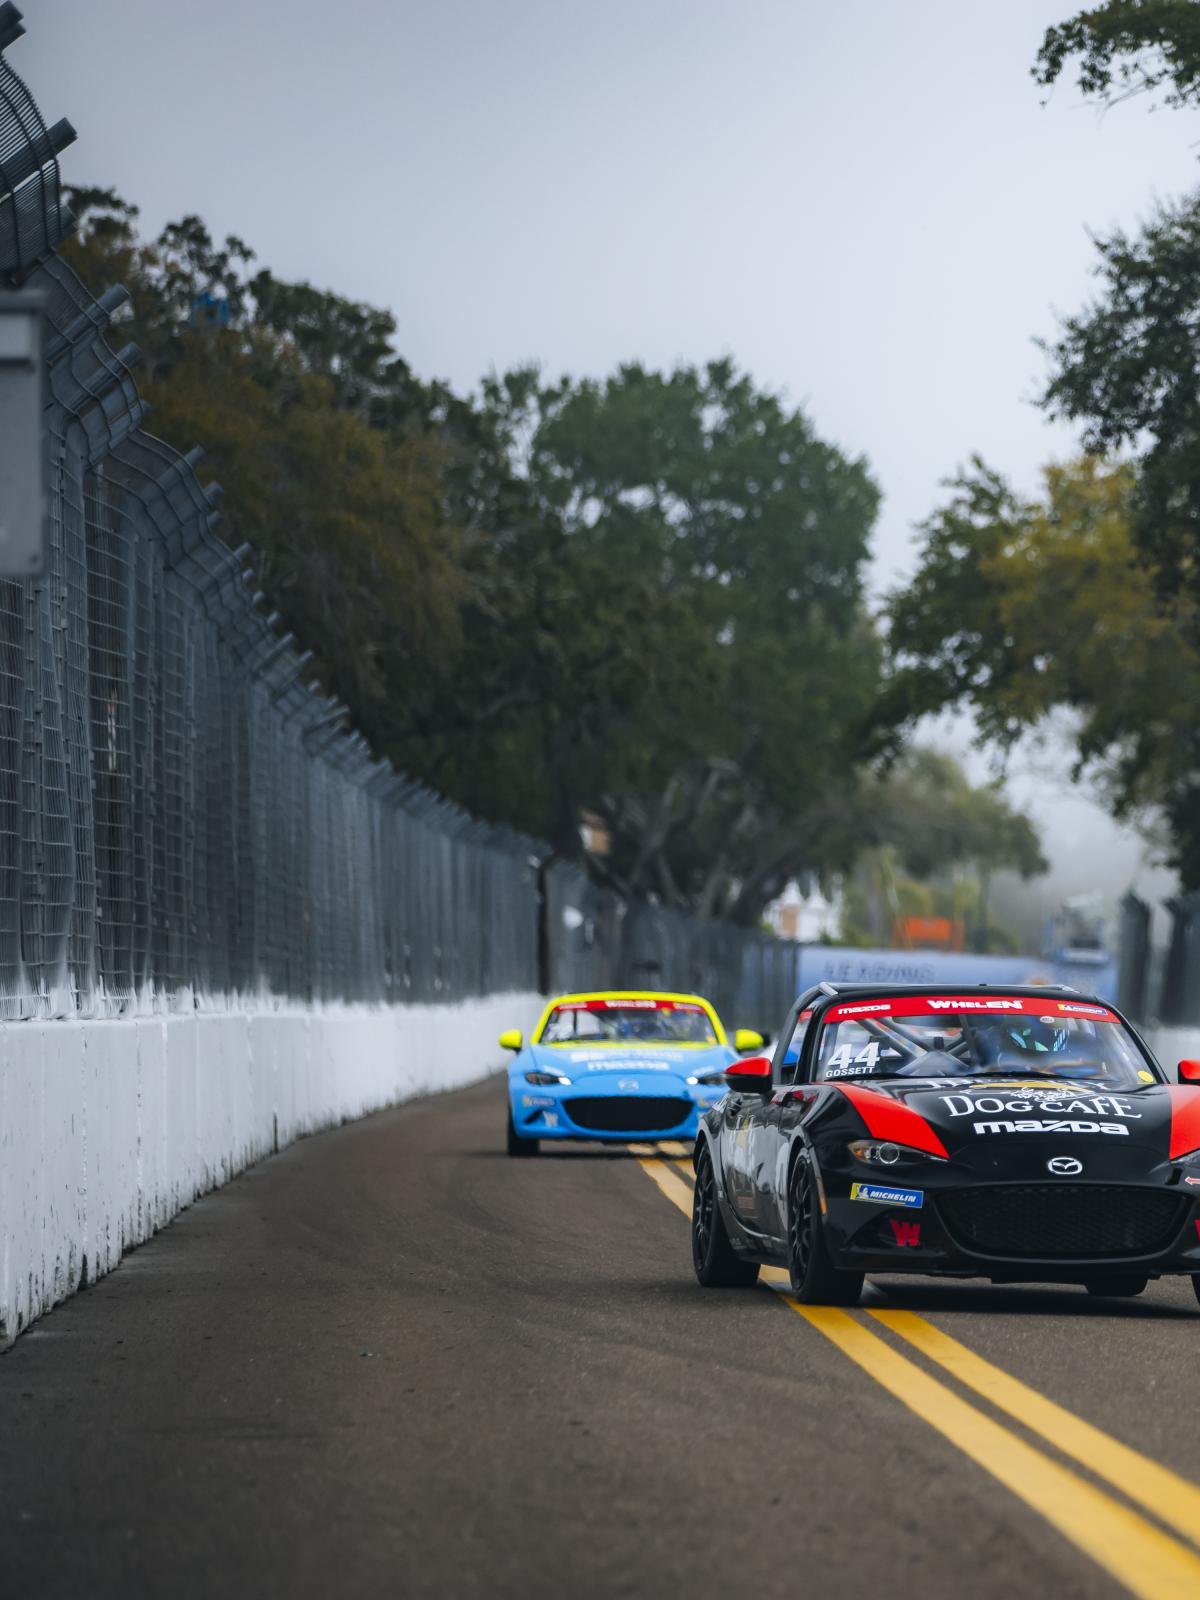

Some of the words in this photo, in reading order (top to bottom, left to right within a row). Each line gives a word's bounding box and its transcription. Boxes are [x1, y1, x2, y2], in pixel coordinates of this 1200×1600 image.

[927, 1000, 1022, 1010] WHELEN
[828, 1042, 880, 1069] 44
[826, 1066, 874, 1078] GOSSETT
[870, 1191, 916, 1202] MICHELIN
[889, 1219, 921, 1247] W
